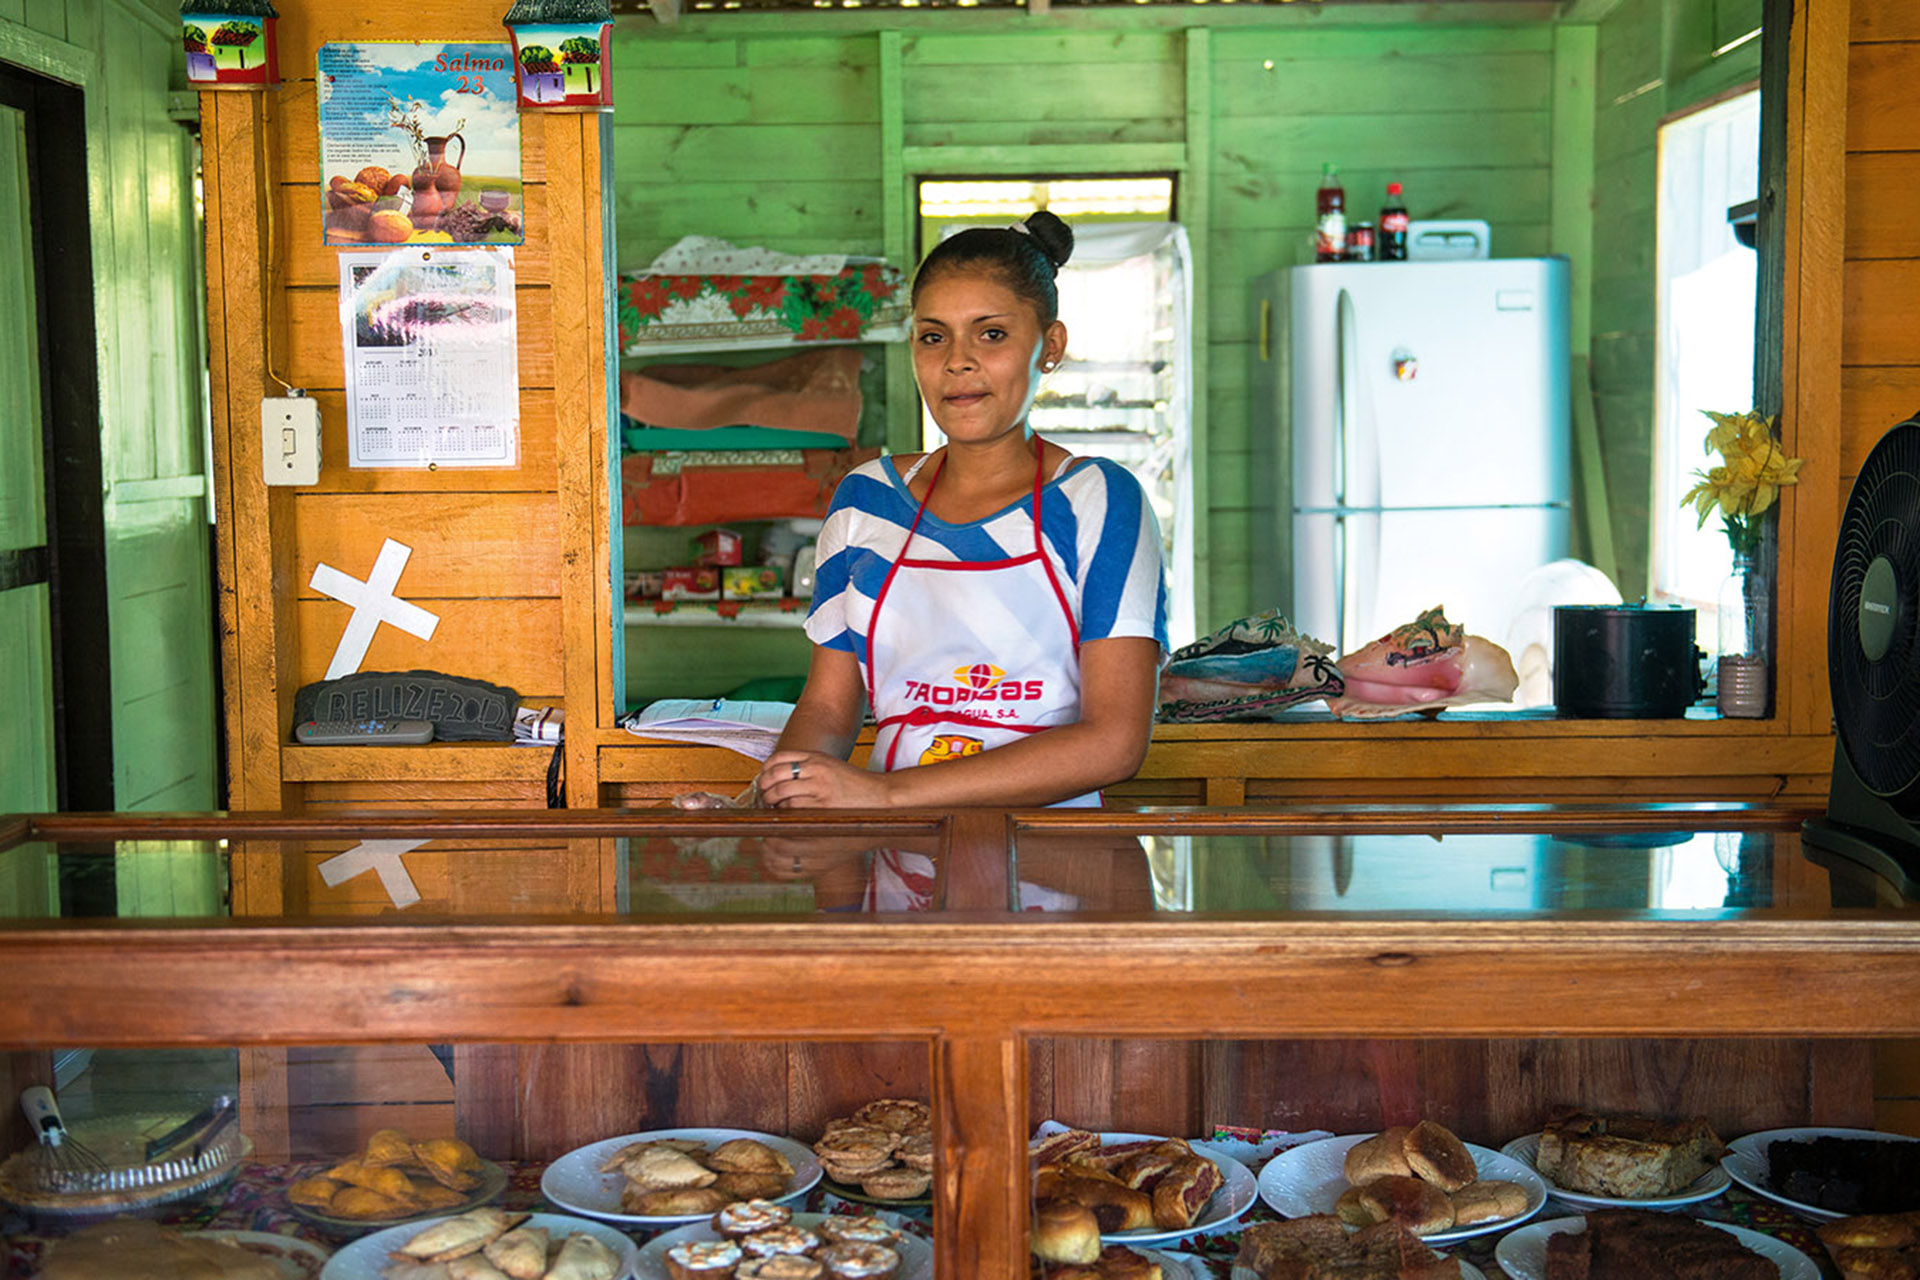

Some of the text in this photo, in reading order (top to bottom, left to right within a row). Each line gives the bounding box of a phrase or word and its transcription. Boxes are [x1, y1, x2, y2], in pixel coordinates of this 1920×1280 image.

[434, 52, 505, 73] Salmo
[456, 75, 485, 95] 23
[328, 683, 447, 721] BELIZE
[996, 709, 1020, 719] S.A.
